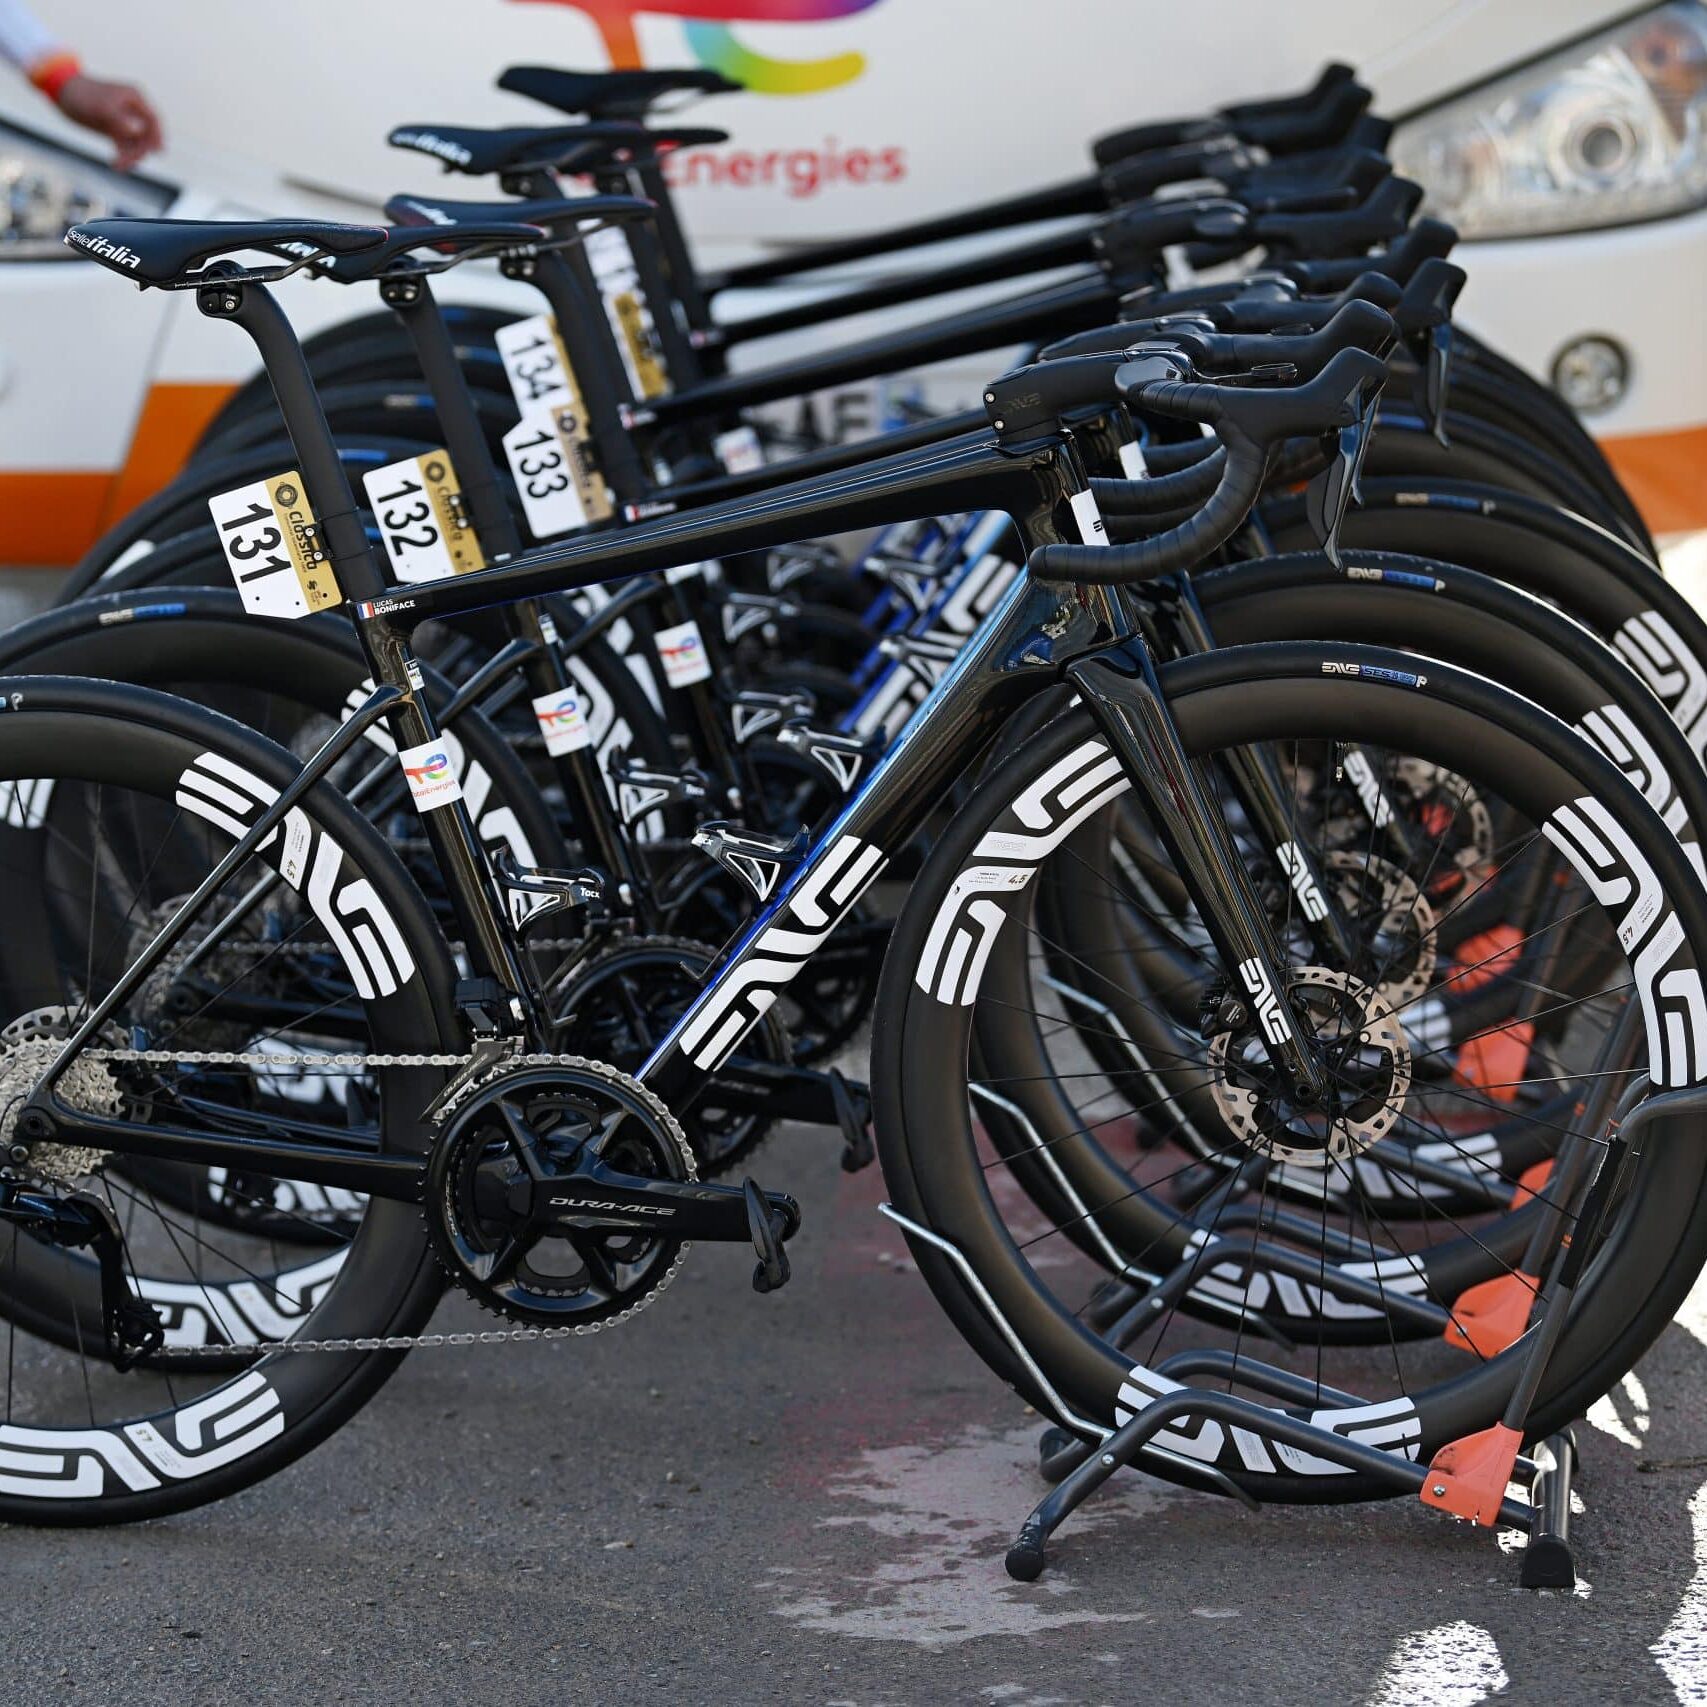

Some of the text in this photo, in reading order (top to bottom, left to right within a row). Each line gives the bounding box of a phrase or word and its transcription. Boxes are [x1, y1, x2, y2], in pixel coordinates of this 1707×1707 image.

[511, 336, 561, 399] 134
[514, 430, 568, 498] 133
[222, 503, 292, 583] 131
[378, 480, 438, 556] 132
[373, 599, 394, 609] LUCAS
[374, 600, 416, 616] BONIFACE
[1321, 661, 1360, 675] ENVE
[175, 752, 416, 1000] ENVE
[580, 887, 600, 898] Tacx
[1008, 874, 1028, 884] 4.5
[1275, 840, 1330, 923] ENVE
[680, 835, 890, 1072] ENVE
[1541, 796, 1707, 1088] ENVE
[1239, 957, 1292, 1045] ENVE
[549, 1197, 677, 1216] DURA-ACE
